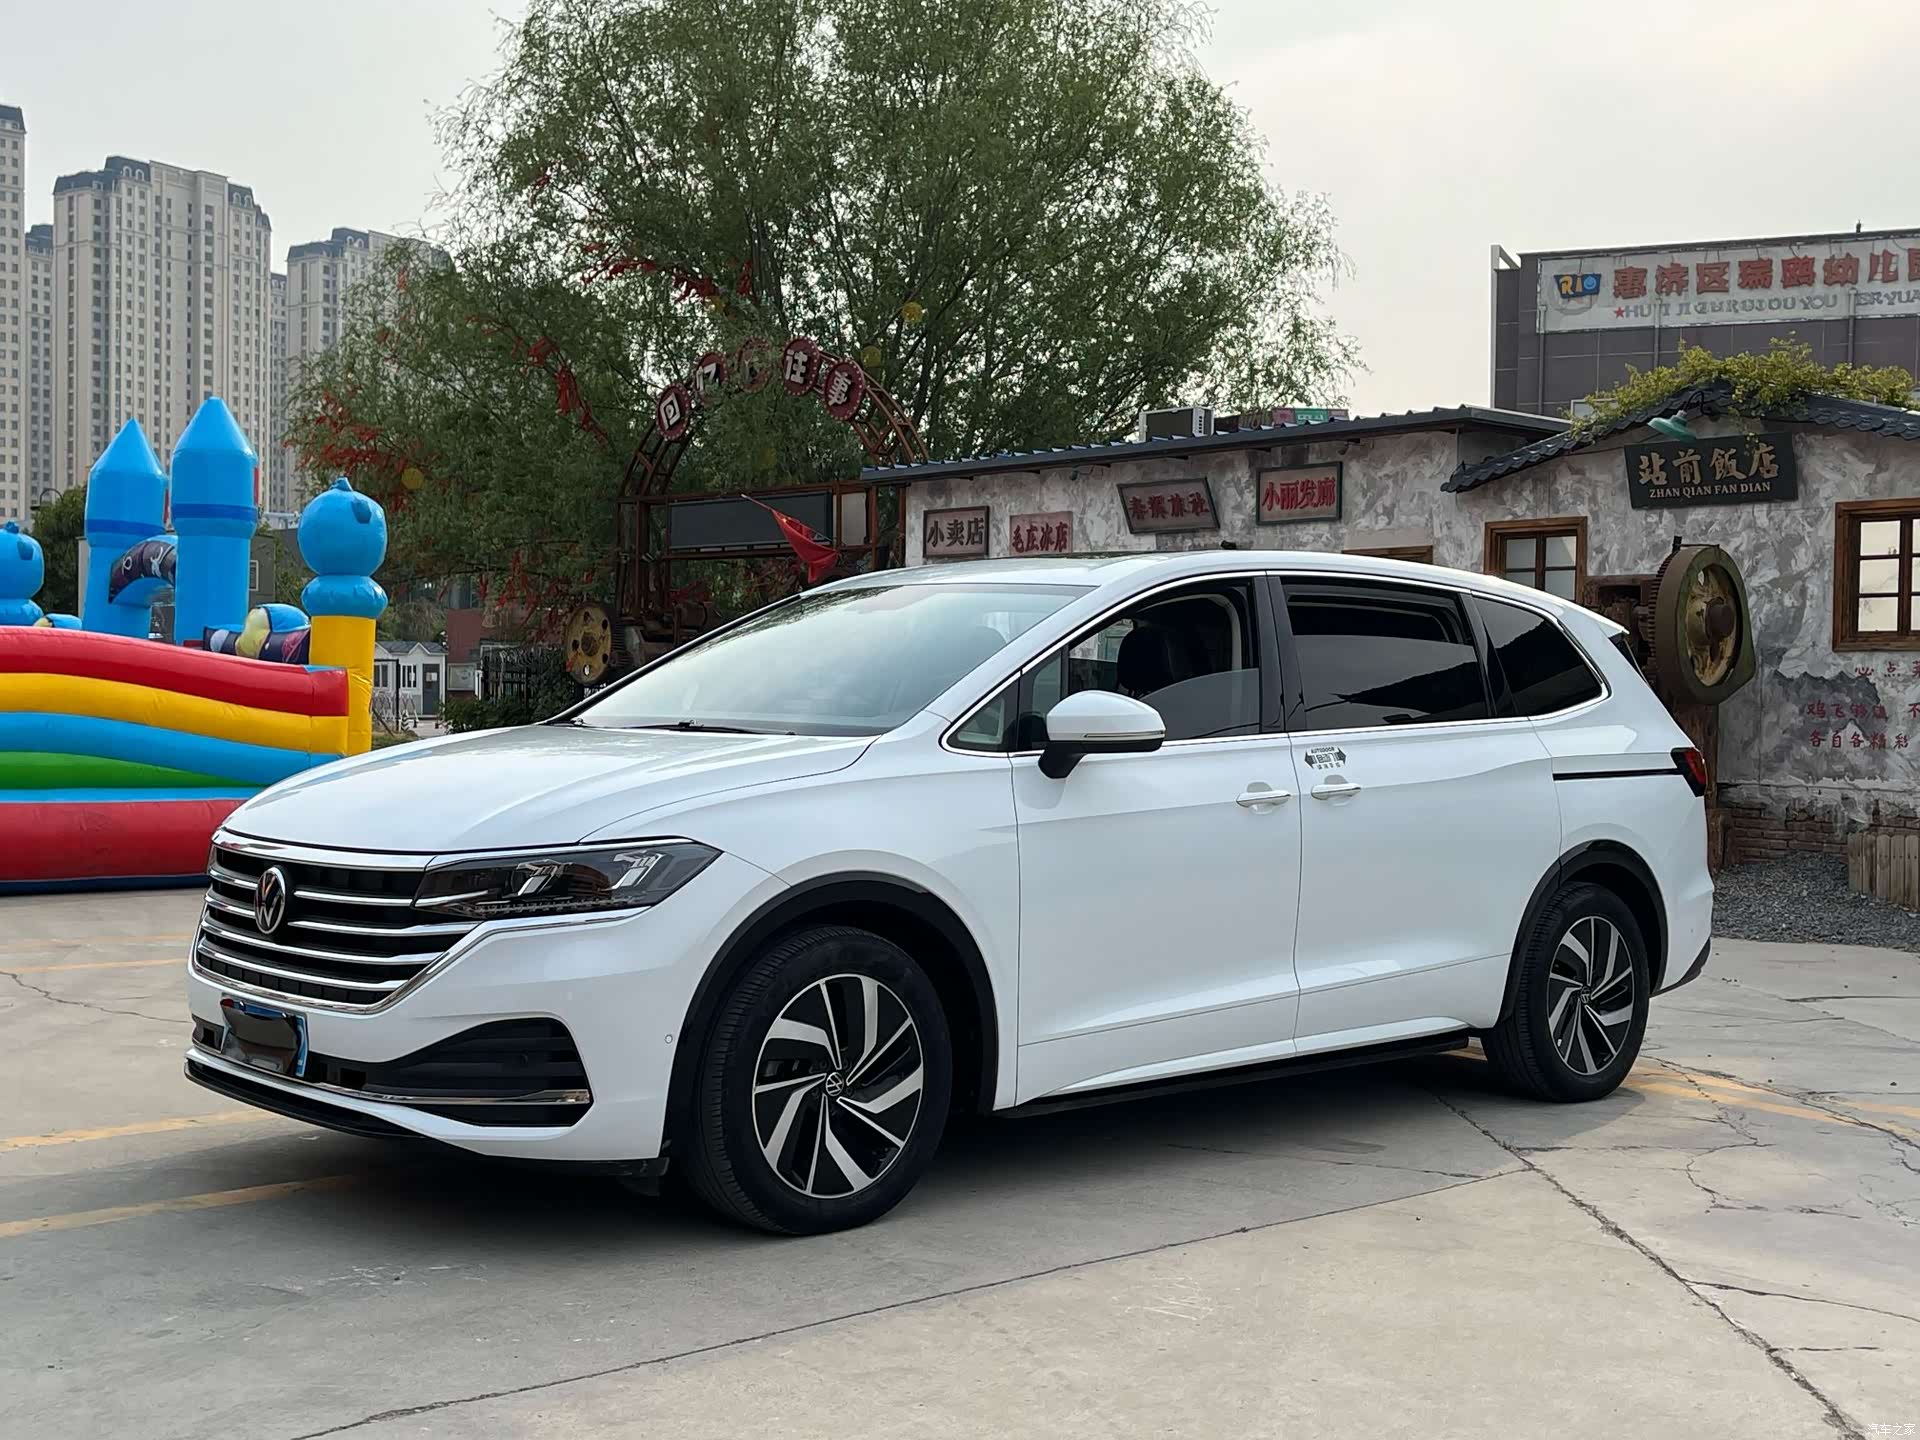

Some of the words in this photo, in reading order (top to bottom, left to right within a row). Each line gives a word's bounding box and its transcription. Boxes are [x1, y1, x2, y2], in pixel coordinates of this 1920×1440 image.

[1262, 477, 1336, 512] 小丽发廊
[1650, 487, 1680, 499] ZHAN
[1682, 486, 1712, 499] QIAN
[1714, 484, 1738, 495] FAN
[1740, 481, 1771, 493] DIAN
[927, 517, 985, 548] 小卖店
